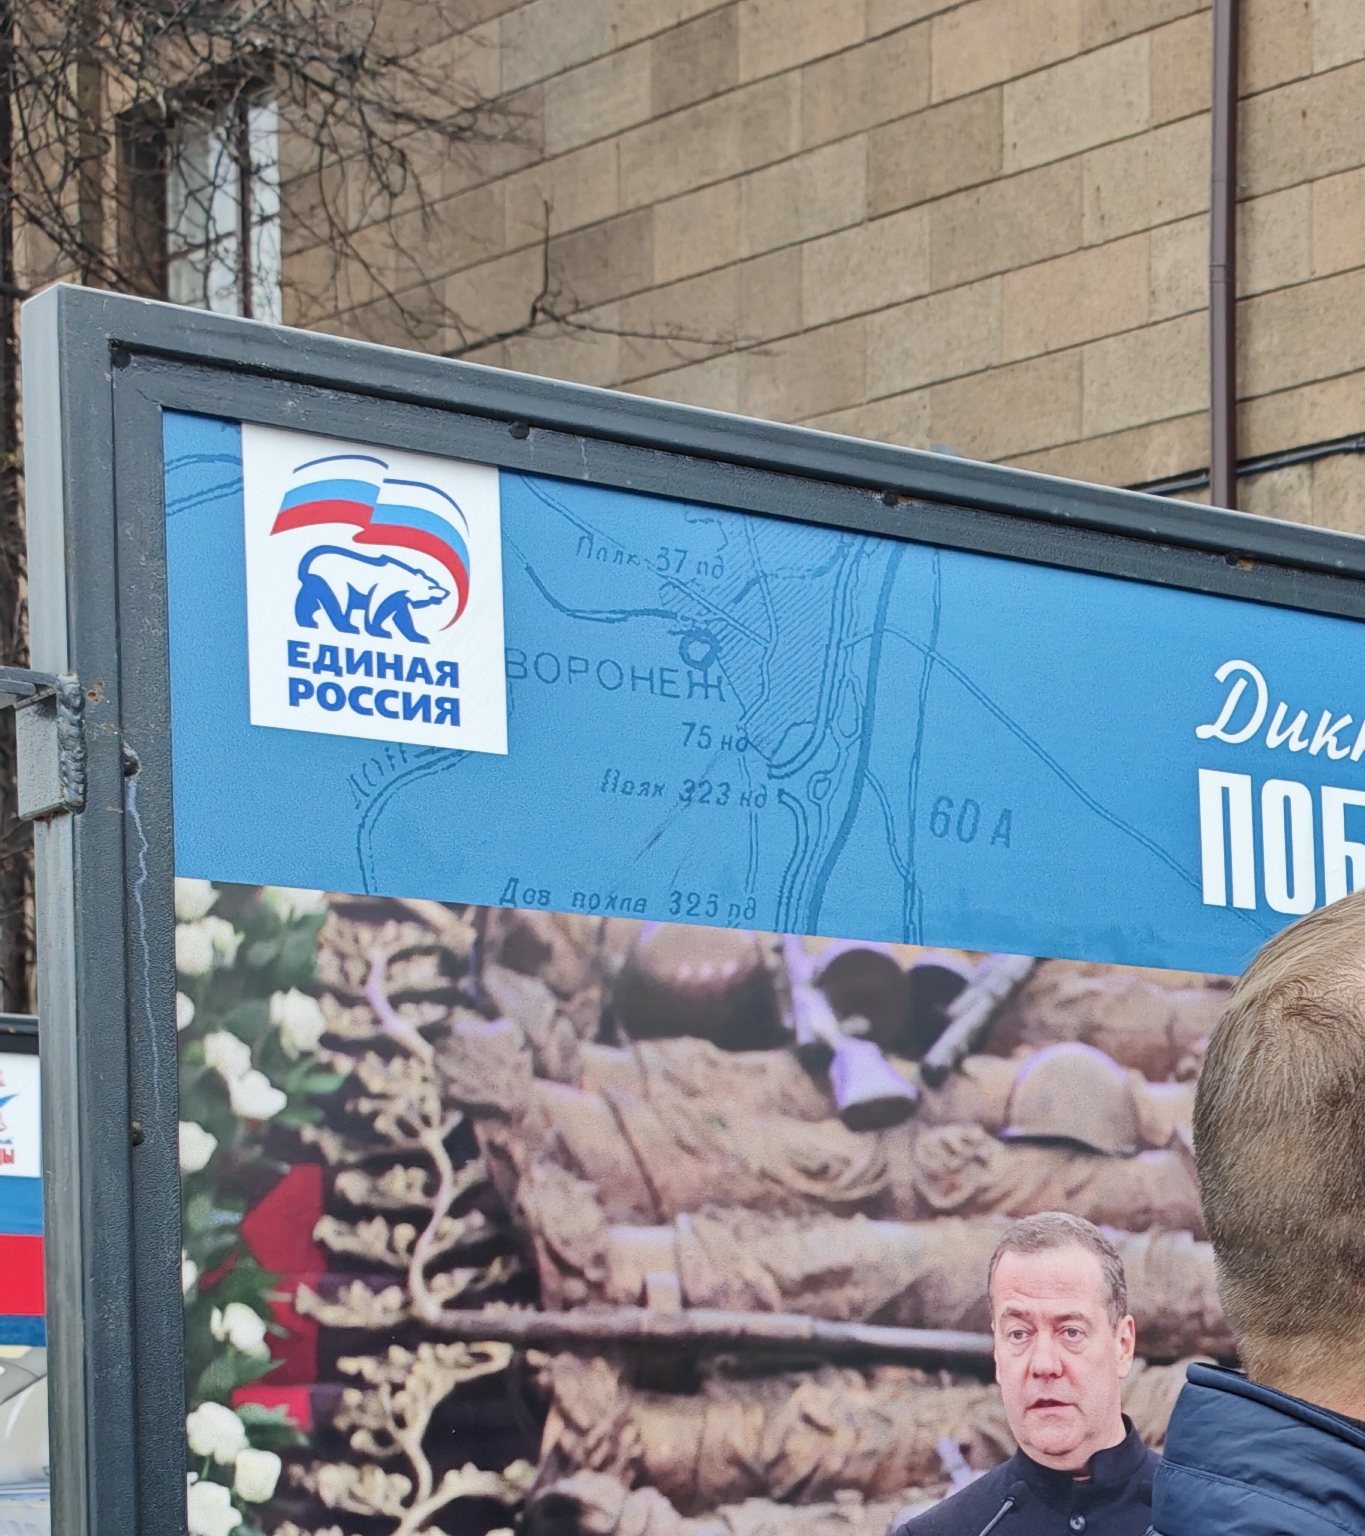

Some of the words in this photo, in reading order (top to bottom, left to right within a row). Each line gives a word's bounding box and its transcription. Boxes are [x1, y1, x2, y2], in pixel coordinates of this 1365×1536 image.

[287, 639, 459, 689] ЕДИНАЯ
[505, 646, 726, 702] ВОРОНЕЖ
[288, 676, 461, 727] РОССИЯ
[682, 722, 711, 749] 75
[929, 795, 981, 843] 60
